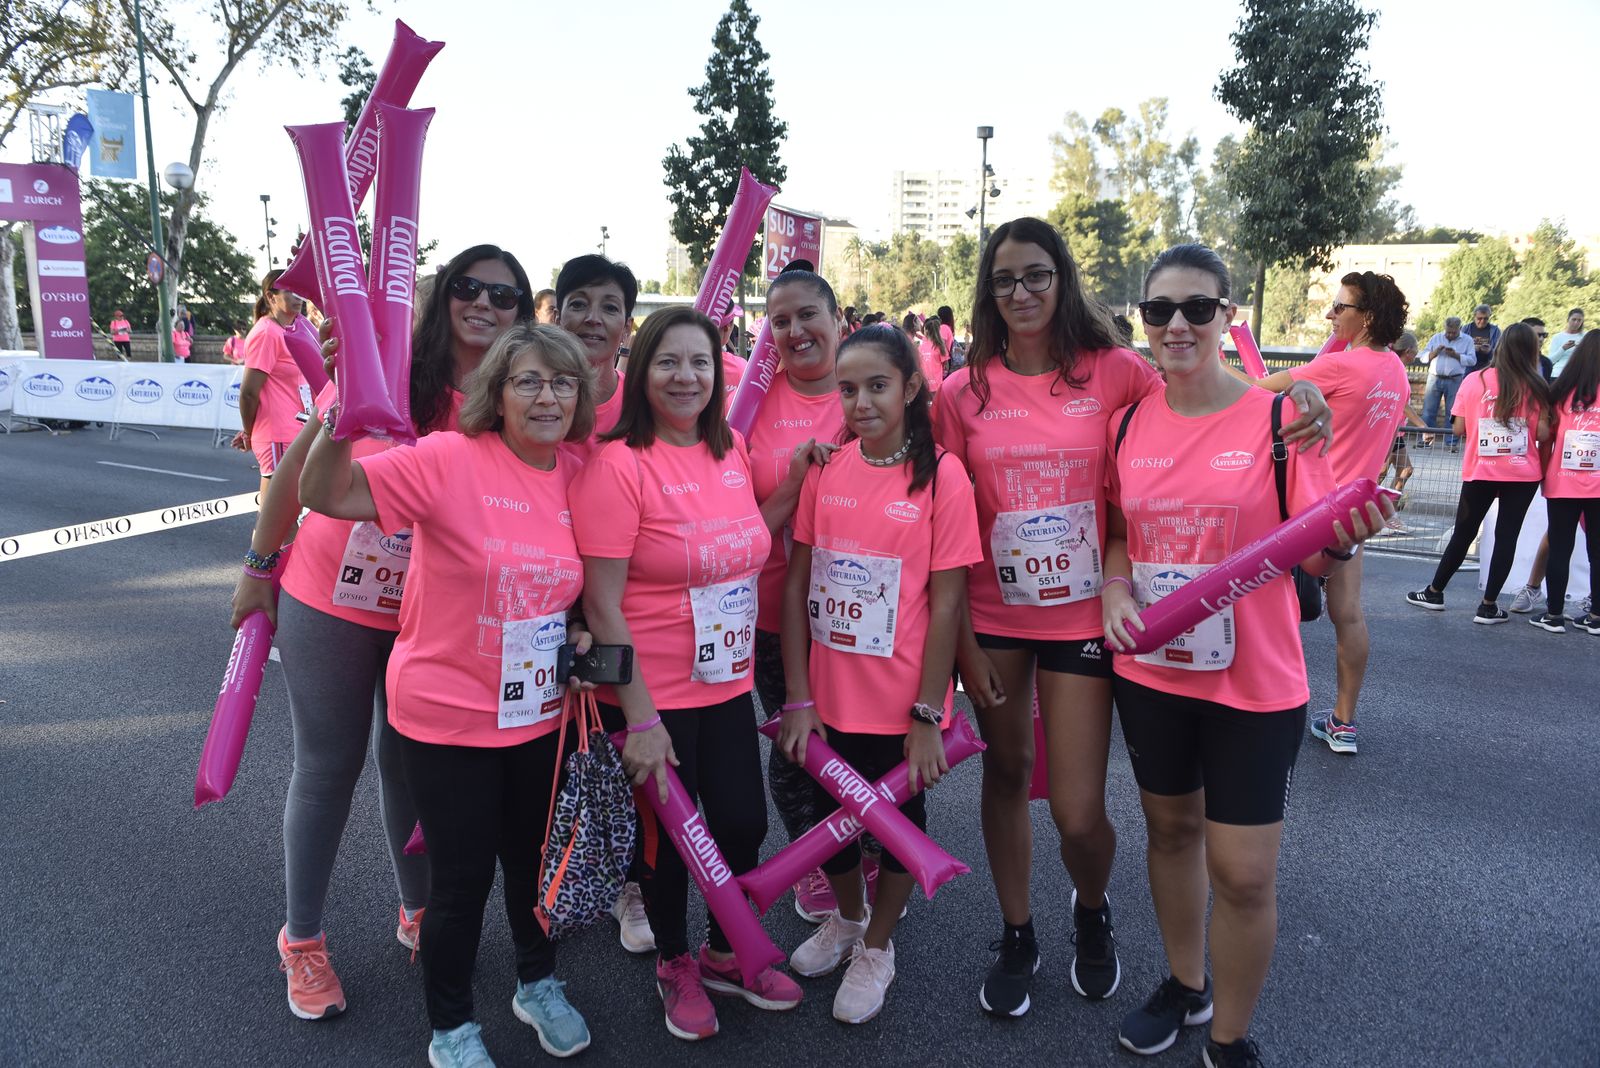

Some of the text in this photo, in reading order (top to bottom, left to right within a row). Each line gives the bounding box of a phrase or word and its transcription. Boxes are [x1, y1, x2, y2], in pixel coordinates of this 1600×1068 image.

[24, 195, 62, 206] ZURICH
[770, 210, 795, 237] SUB
[324, 217, 369, 299] Ladival
[386, 216, 418, 308] Ladival
[42, 292, 86, 302] OYSHO
[51, 329, 84, 338] ZURICH
[78, 384, 113, 396] ASTURIANA
[129, 387, 161, 398] ASTURIANA
[176, 389, 210, 400] ASTURIANA
[984, 409, 1028, 420] OYSHO
[774, 419, 813, 429] OYSHO
[1023, 461, 1052, 470] VITORIA
[1130, 457, 1174, 469] OYSHO
[482, 495, 530, 513] OYSHO
[821, 495, 857, 509] OYSHO
[1159, 517, 1188, 526] VITORIA
[1020, 525, 1067, 538] ASTURIANA
[384, 538, 412, 553] ASTUR
[1026, 553, 1070, 574] 016
[375, 567, 405, 586] 01
[829, 567, 867, 582] ASTURIANA
[1039, 575, 1061, 585] 5511
[1153, 581, 1180, 592] ASTURI
[1200, 558, 1285, 613] Ladival
[339, 592, 368, 601] OYSHO
[826, 597, 862, 619] 016
[831, 620, 850, 631] 5514
[724, 624, 751, 648] 016
[1166, 637, 1185, 647] 510
[535, 665, 555, 687] 01
[543, 687, 559, 699] 5512
[820, 758, 879, 816] Ladival
[682, 811, 732, 887] Ladival
